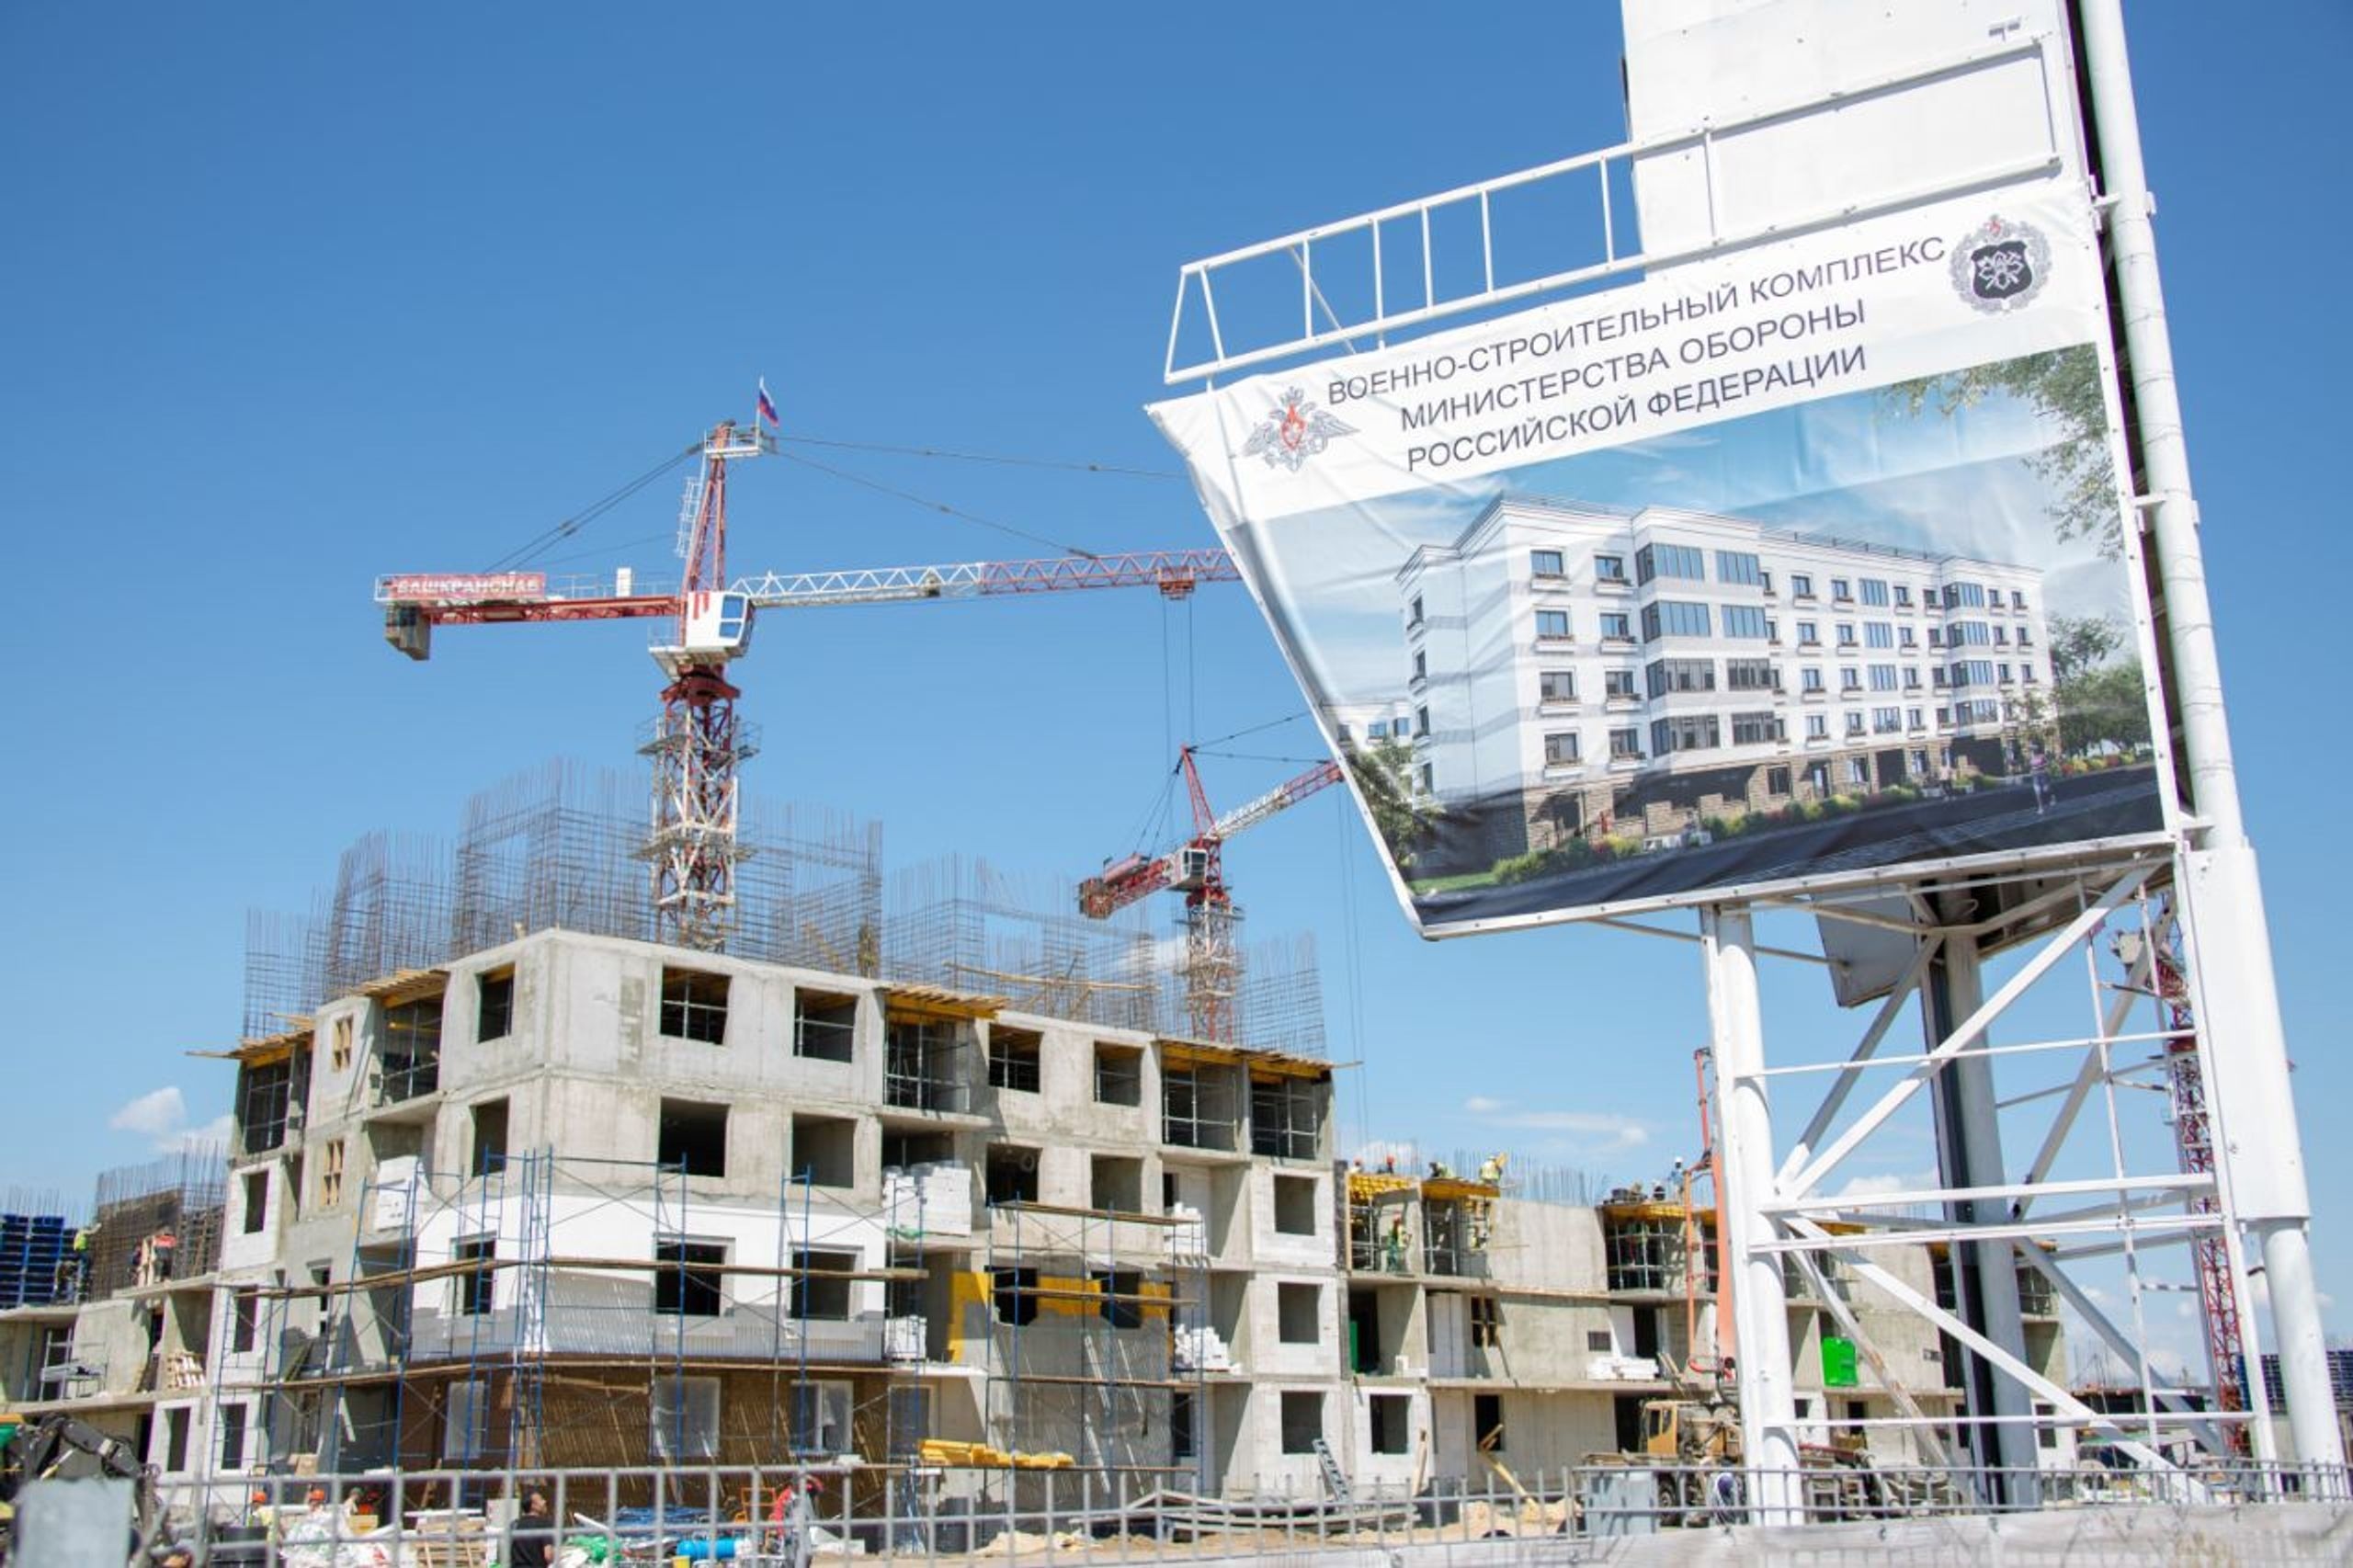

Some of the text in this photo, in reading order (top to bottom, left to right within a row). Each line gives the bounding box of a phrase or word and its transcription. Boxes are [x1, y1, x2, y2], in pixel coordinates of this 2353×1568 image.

[1329, 237, 1945, 404] ВОЕННО-СТРОИТЕЛЬНЫЙ КОМПЛЕКС
[1401, 300, 1865, 430] МИНИСТЕРСТВА ОБОРОНЫ
[1408, 346, 1866, 472] РОССИЙСКОЙ ФЕДЕРАЦИИ
